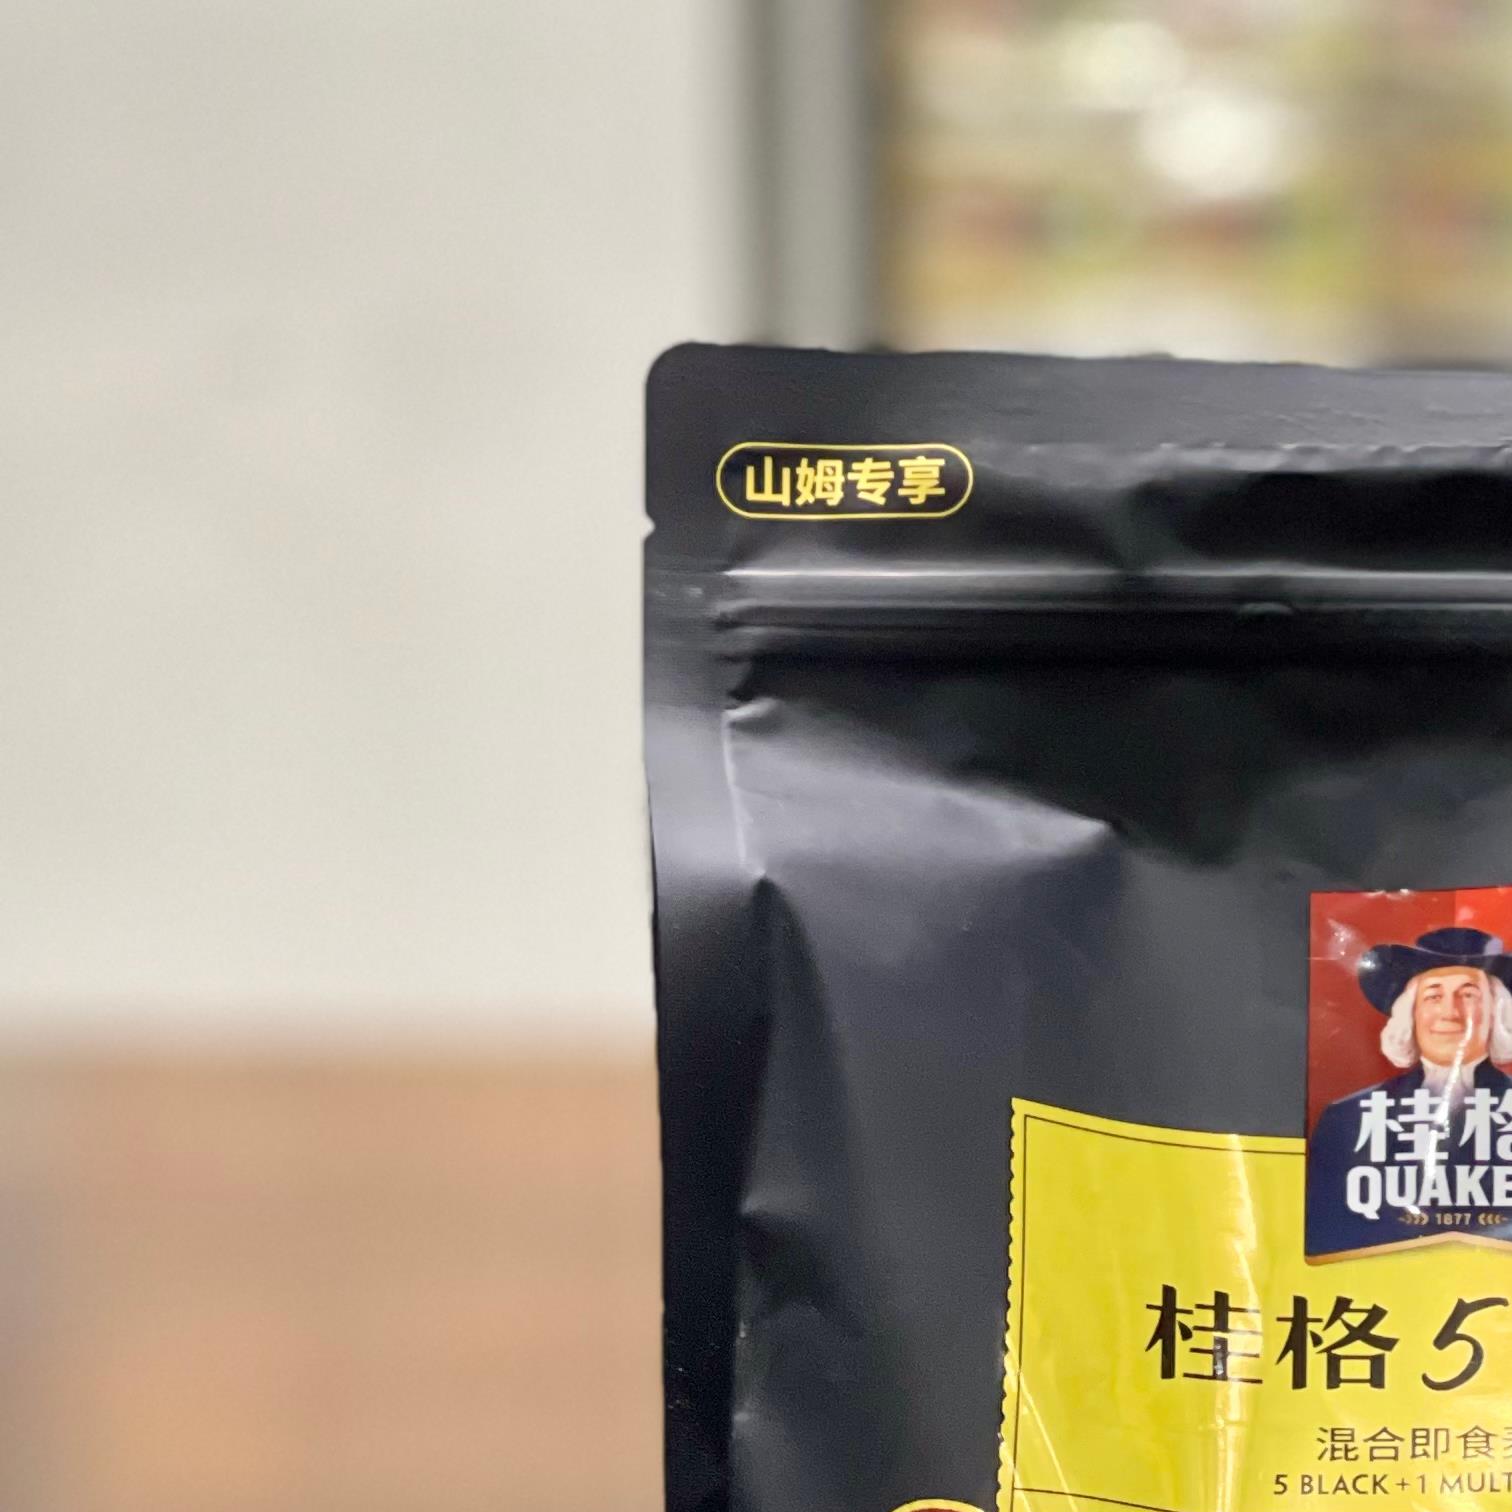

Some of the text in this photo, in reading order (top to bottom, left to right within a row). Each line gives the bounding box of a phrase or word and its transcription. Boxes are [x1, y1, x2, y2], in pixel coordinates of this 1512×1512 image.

[746, 456, 945, 507] 山姆专享
[1435, 1213, 1472, 1226] 1877
[1274, 1475, 1289, 1496] 5
